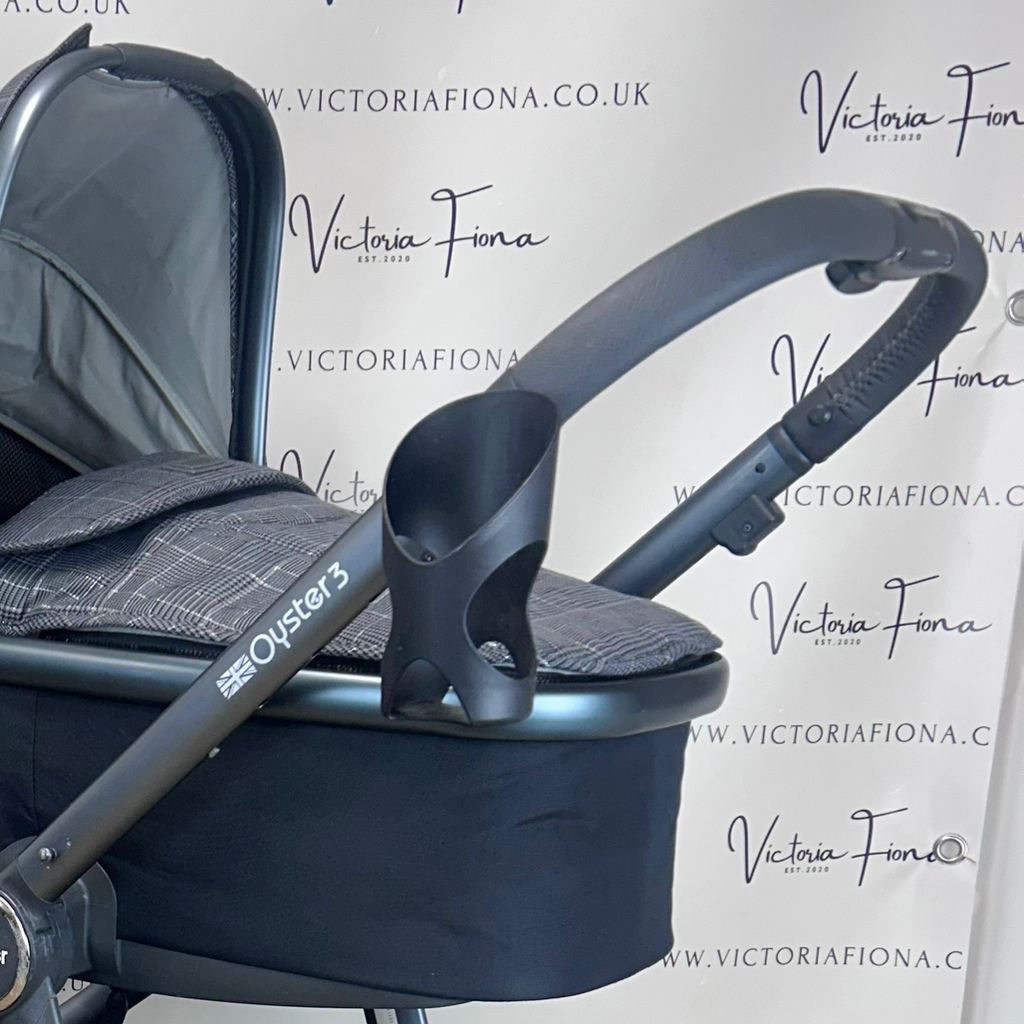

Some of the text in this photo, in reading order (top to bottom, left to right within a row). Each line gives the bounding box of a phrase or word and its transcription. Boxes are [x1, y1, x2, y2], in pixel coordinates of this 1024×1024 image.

[800, 69, 946, 154] Victoria
[866, 133, 921, 142] EST.2020
[288, 185, 550, 278] Victoria Fiona
[358, 255, 411, 263] EST.2020
[750, 575, 992, 660] Victoria Fiona
[814, 638, 862, 646] EST.2020
[728, 808, 937, 887] Victoria Fion
[784, 865, 830, 874] EST.2020
